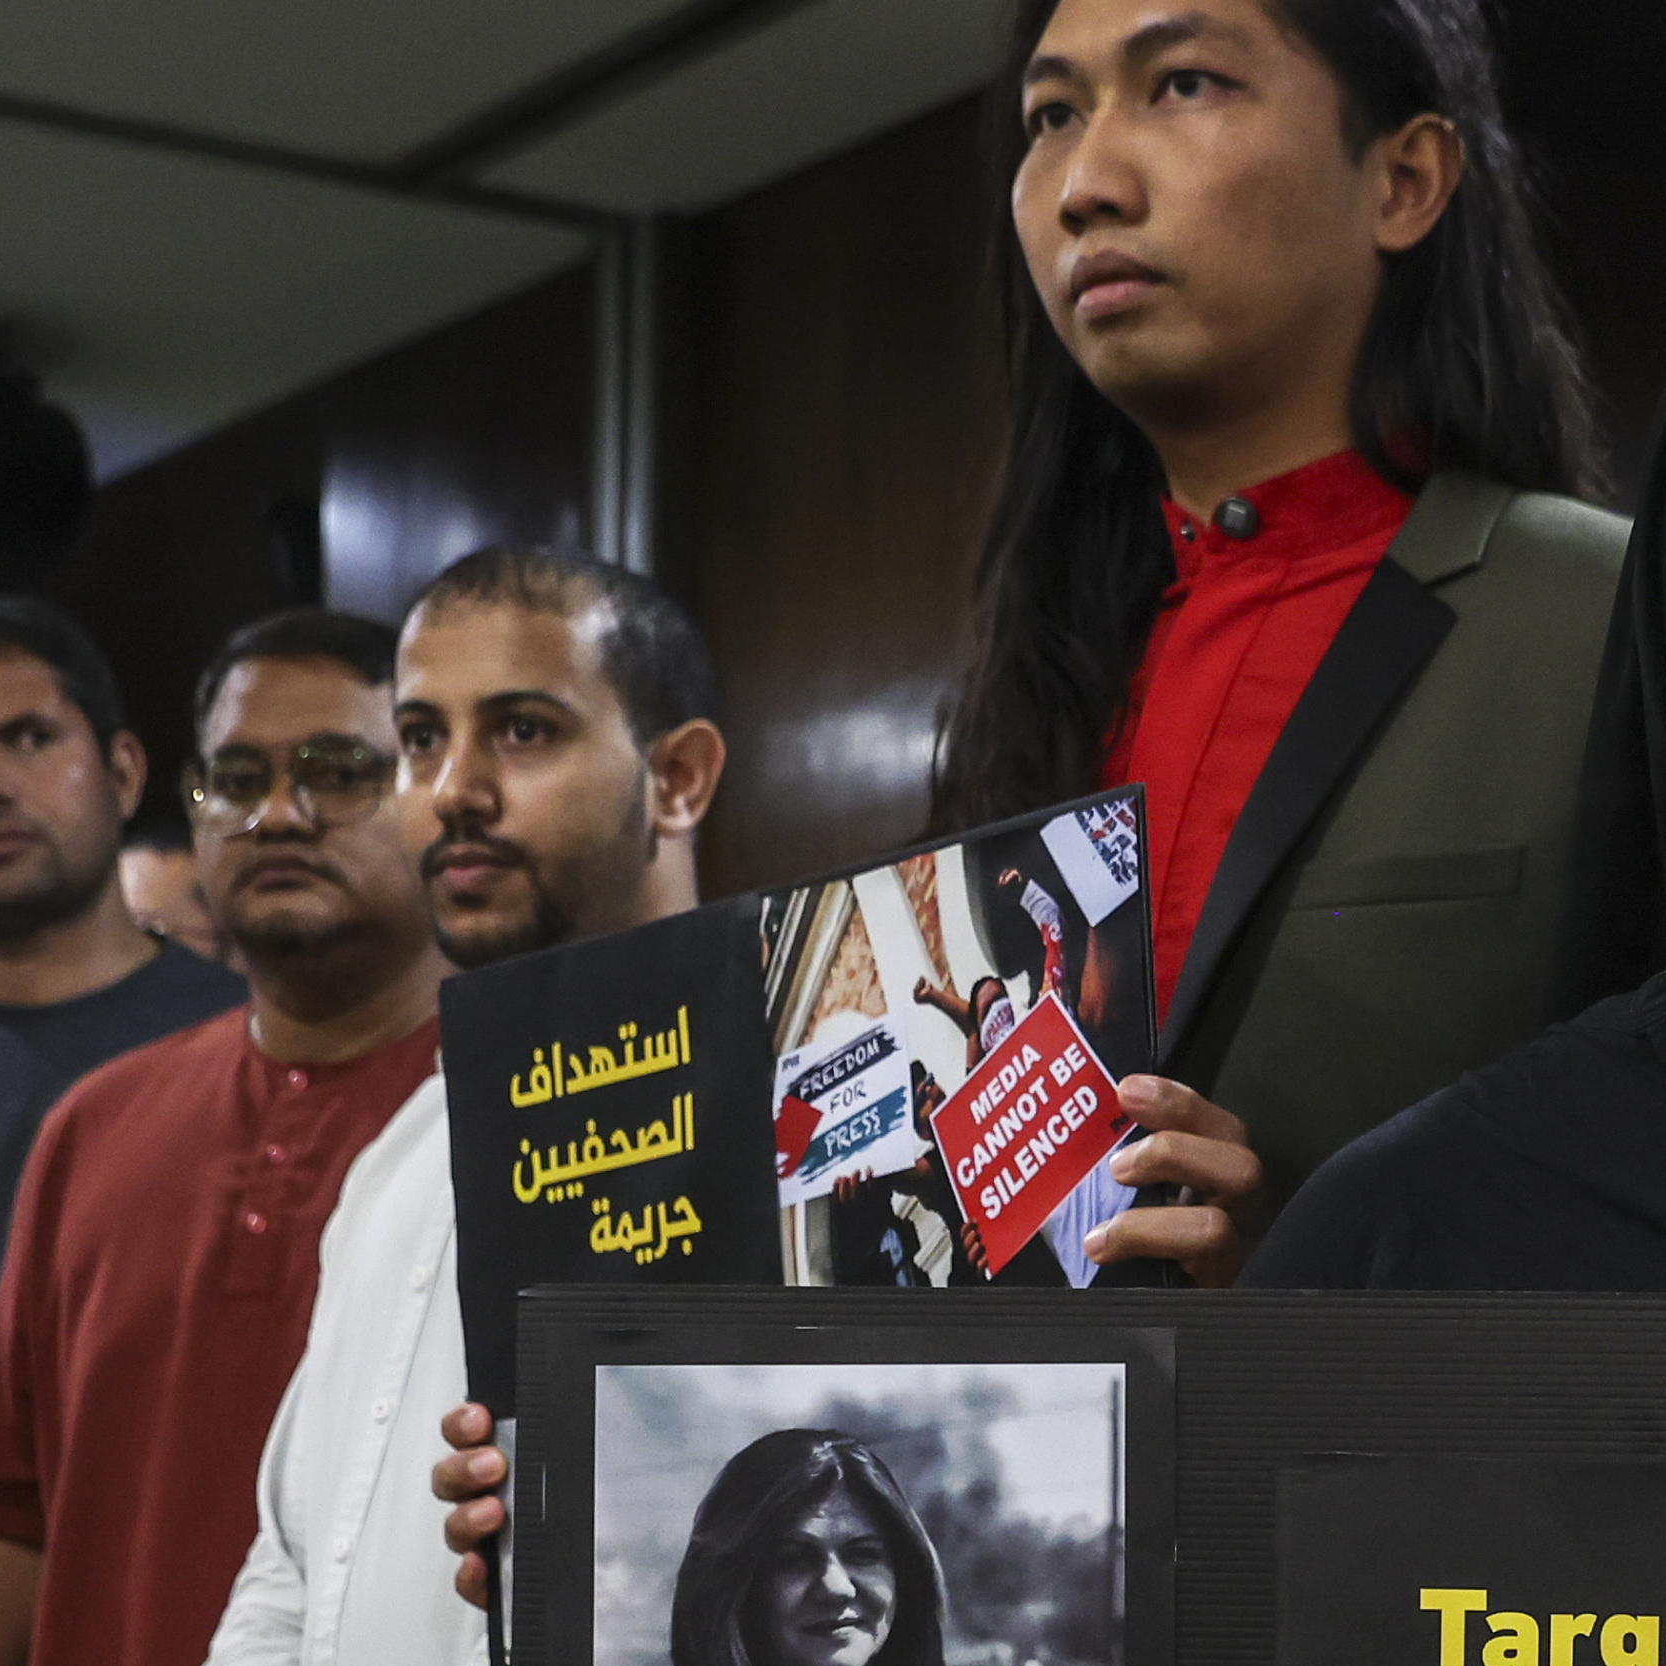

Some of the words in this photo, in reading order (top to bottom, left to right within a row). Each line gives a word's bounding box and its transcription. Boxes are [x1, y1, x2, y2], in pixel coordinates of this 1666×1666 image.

[510, 1005, 693, 1109] استهداف
[799, 1038, 881, 1100] FREEDOM
[830, 1080, 867, 1114] FOR
[969, 1043, 1043, 1125] MEDIA
[511, 1094, 695, 1204] الصحفيين
[824, 1107, 882, 1158] PRESS
[956, 1075, 1050, 1188] CANNOT
[1048, 1042, 1087, 1087] BE
[980, 1085, 1098, 1220] SILENCED
[589, 1195, 702, 1265] جريمة
